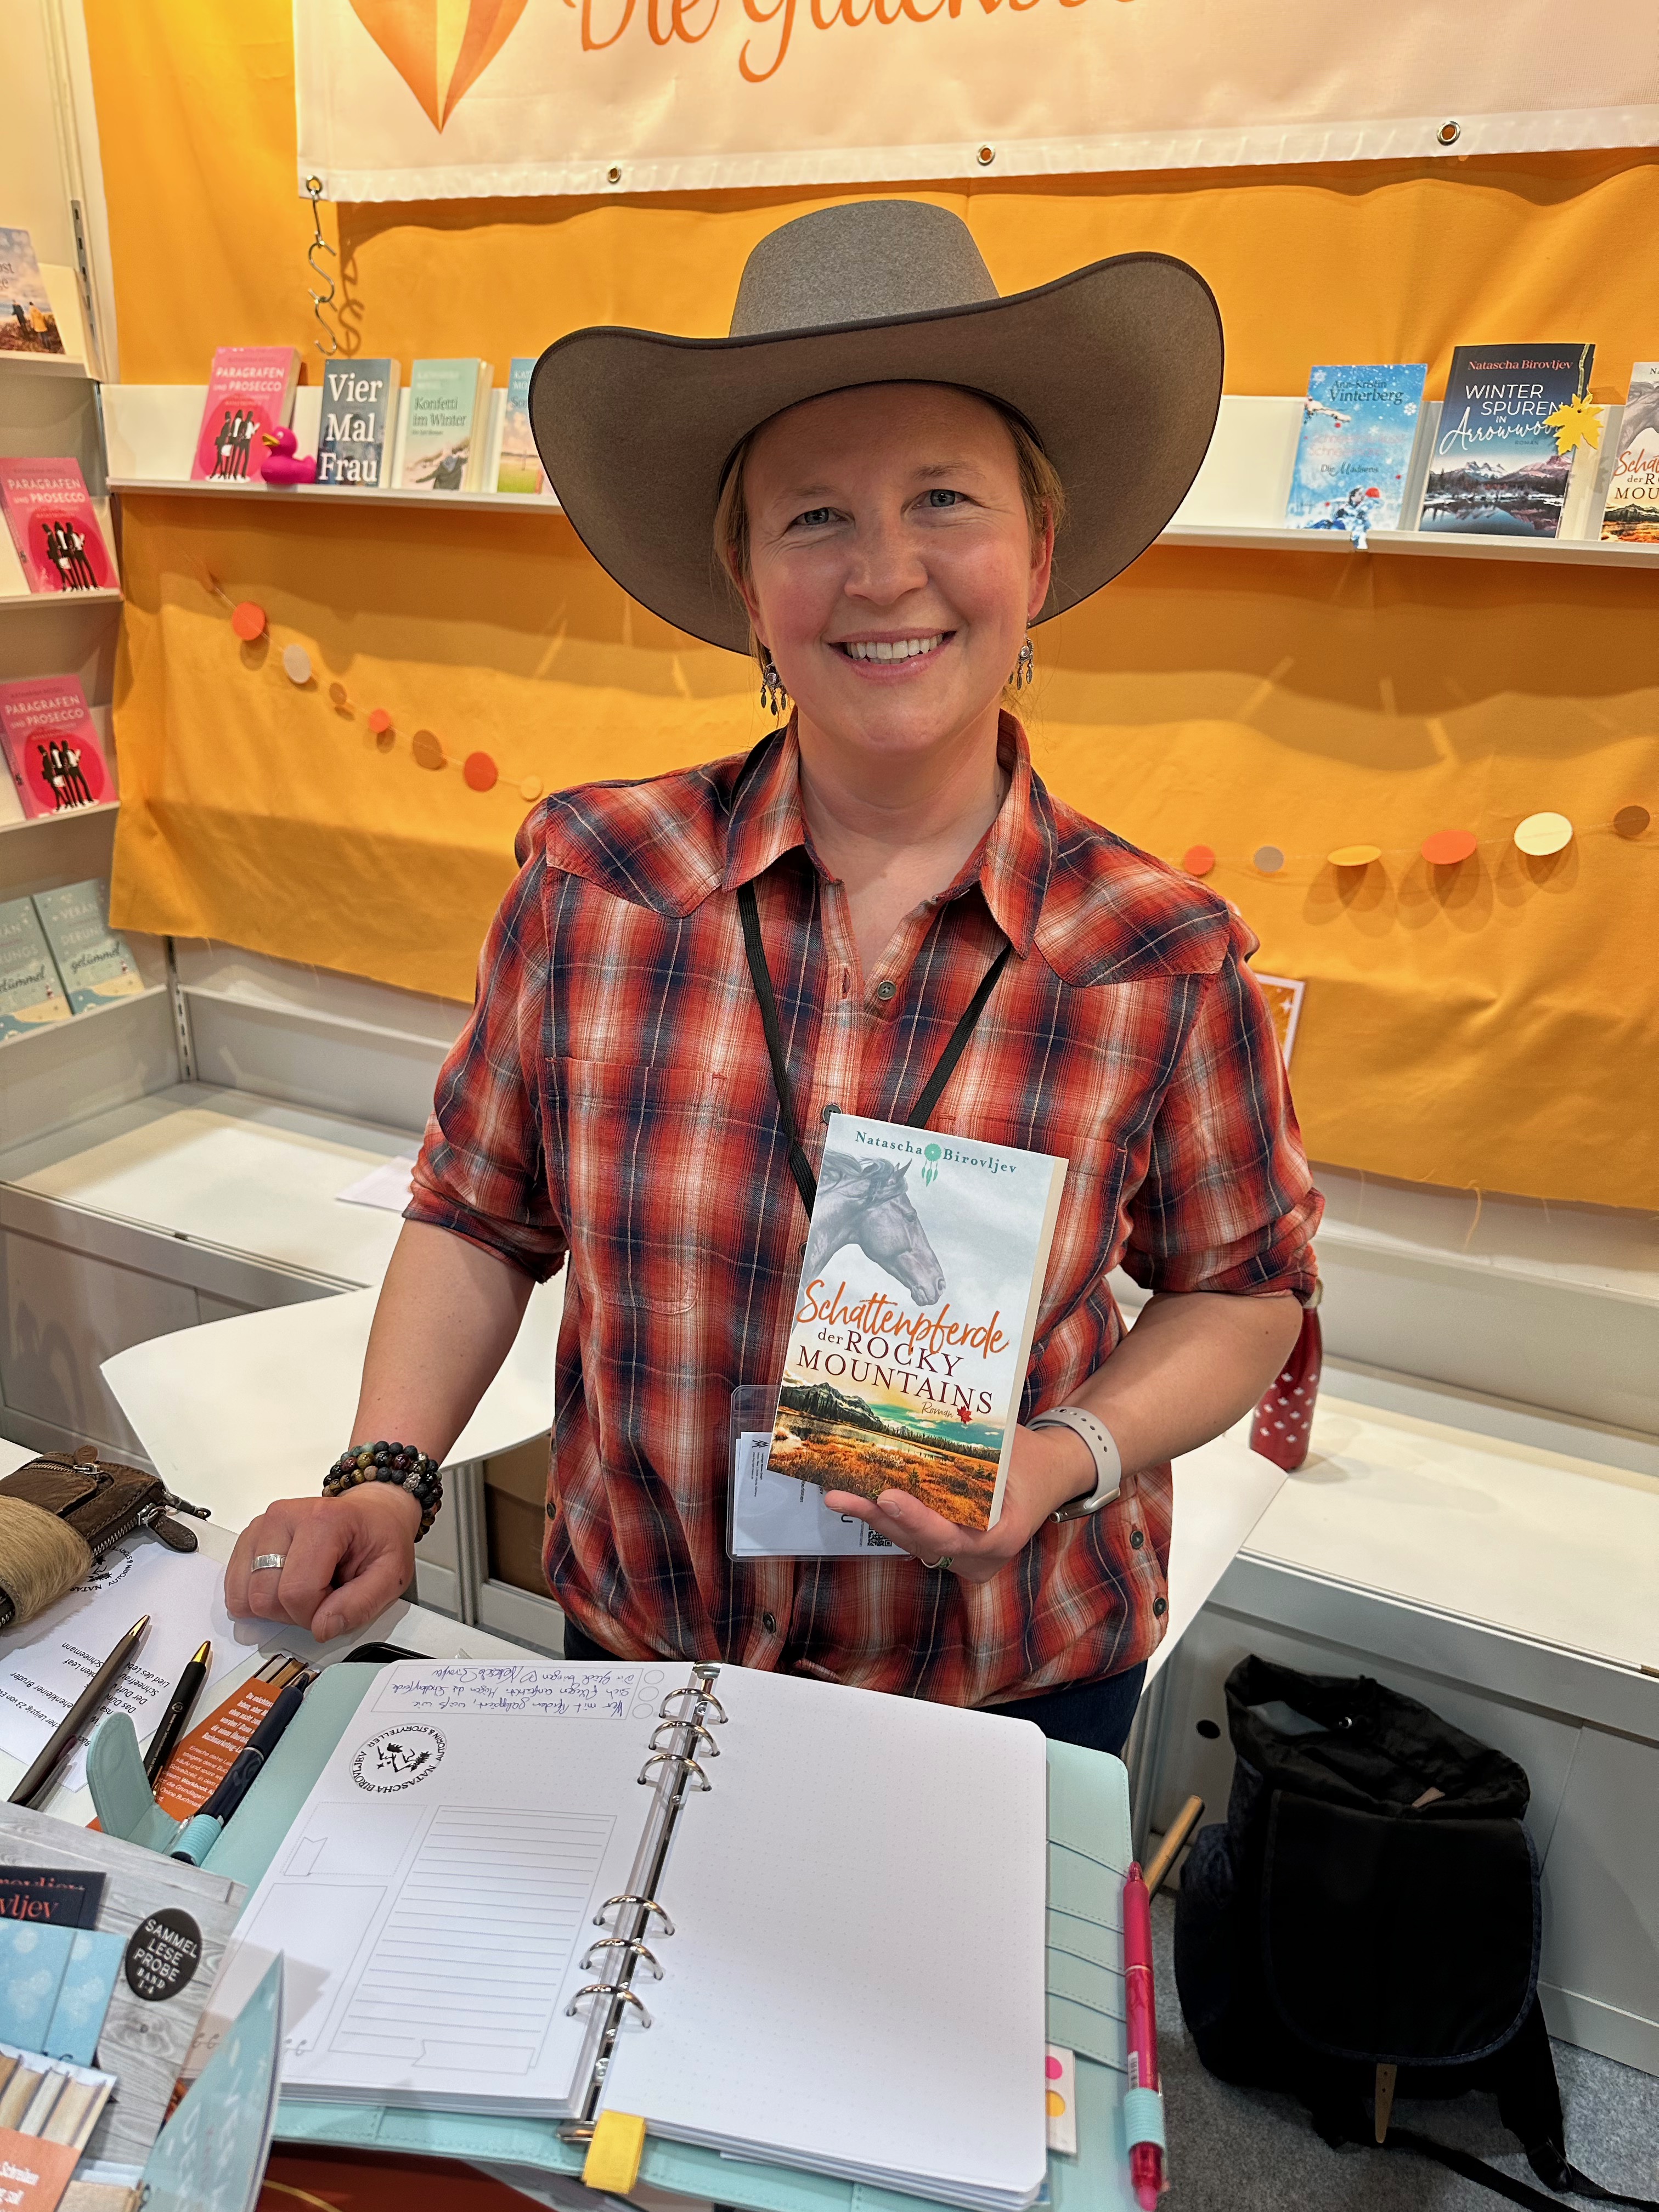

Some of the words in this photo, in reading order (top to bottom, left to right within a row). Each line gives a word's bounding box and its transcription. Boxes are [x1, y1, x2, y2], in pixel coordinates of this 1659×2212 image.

[216, 366, 285, 379] PARAGRAFEN
[1468, 360, 1520, 370] Natascha
[1521, 359, 1573, 371] Birovljev
[228, 380, 283, 392] PROSECCO
[327, 372, 383, 402] Vier
[1465, 384, 1544, 399] WINTER
[1330, 388, 1404, 406] Vinterberg
[325, 412, 375, 442] Mal
[412, 413, 428, 427] im
[430, 413, 467, 427] Winter
[1496, 415, 1507, 424] IN
[1439, 406, 1564, 455] Arrowwoo
[317, 452, 378, 482] Frau
[7, 478, 82, 490] PARAGRAFEN
[1627, 475, 1644, 483] der
[30, 492, 86, 504] PROSECCO
[4, 694, 81, 715] PARAGRAFEN
[26, 708, 84, 726] PROSECCO
[854, 1131, 923, 1155] Natascha
[942, 1147, 1018, 1175] Birovljev
[795, 1279, 1012, 1360] Schattenpferde
[817, 1328, 843, 1344] der
[847, 1329, 965, 1378] ROCKY
[797, 1345, 993, 1415] MOUNTAINS
[921, 1401, 954, 1419] Roman
[108, 1564, 133, 1587] AUTORIN
[61, 1642, 104, 1668] Schneemann
[62, 1658, 81, 1670] Leaf
[10, 1672, 35, 1688] Bruder
[140, 1669, 155, 1679] des
[120, 1673, 160, 1697] Schneefrau
[151, 1677, 170, 1688] Lied
[6, 1694, 19, 1704] von
[116, 1685, 134, 1698] Duft
[133, 1694, 149, 1705] Der
[15, 1701, 27, 1709] 23
[121, 1703, 137, 1714] Das
[574, 1702, 596, 1713] mit
[602, 1699, 623, 1718] Wer
[25, 1705, 47, 1722] Leipzig
[367, 1725, 430, 1748] STORYTELLER
[432, 1732, 445, 1762] AUTORIN
[202, 1759, 217, 1769] deine
[209, 1754, 224, 1762] deine
[200, 1768, 216, 1778] spare
[377, 1764, 437, 1793] NATASCHA
[181, 1777, 208, 1792] Workbook
[204, 1778, 217, 1786] dem
[160, 1787, 177, 1797] Online
[176, 1784, 205, 1801] Grundlagen
[145, 1918, 198, 1959] SAMMEL
[148, 1938, 183, 1966] LESE
[133, 1948, 180, 1983] PROBE
[137, 1967, 166, 1989] BAND
